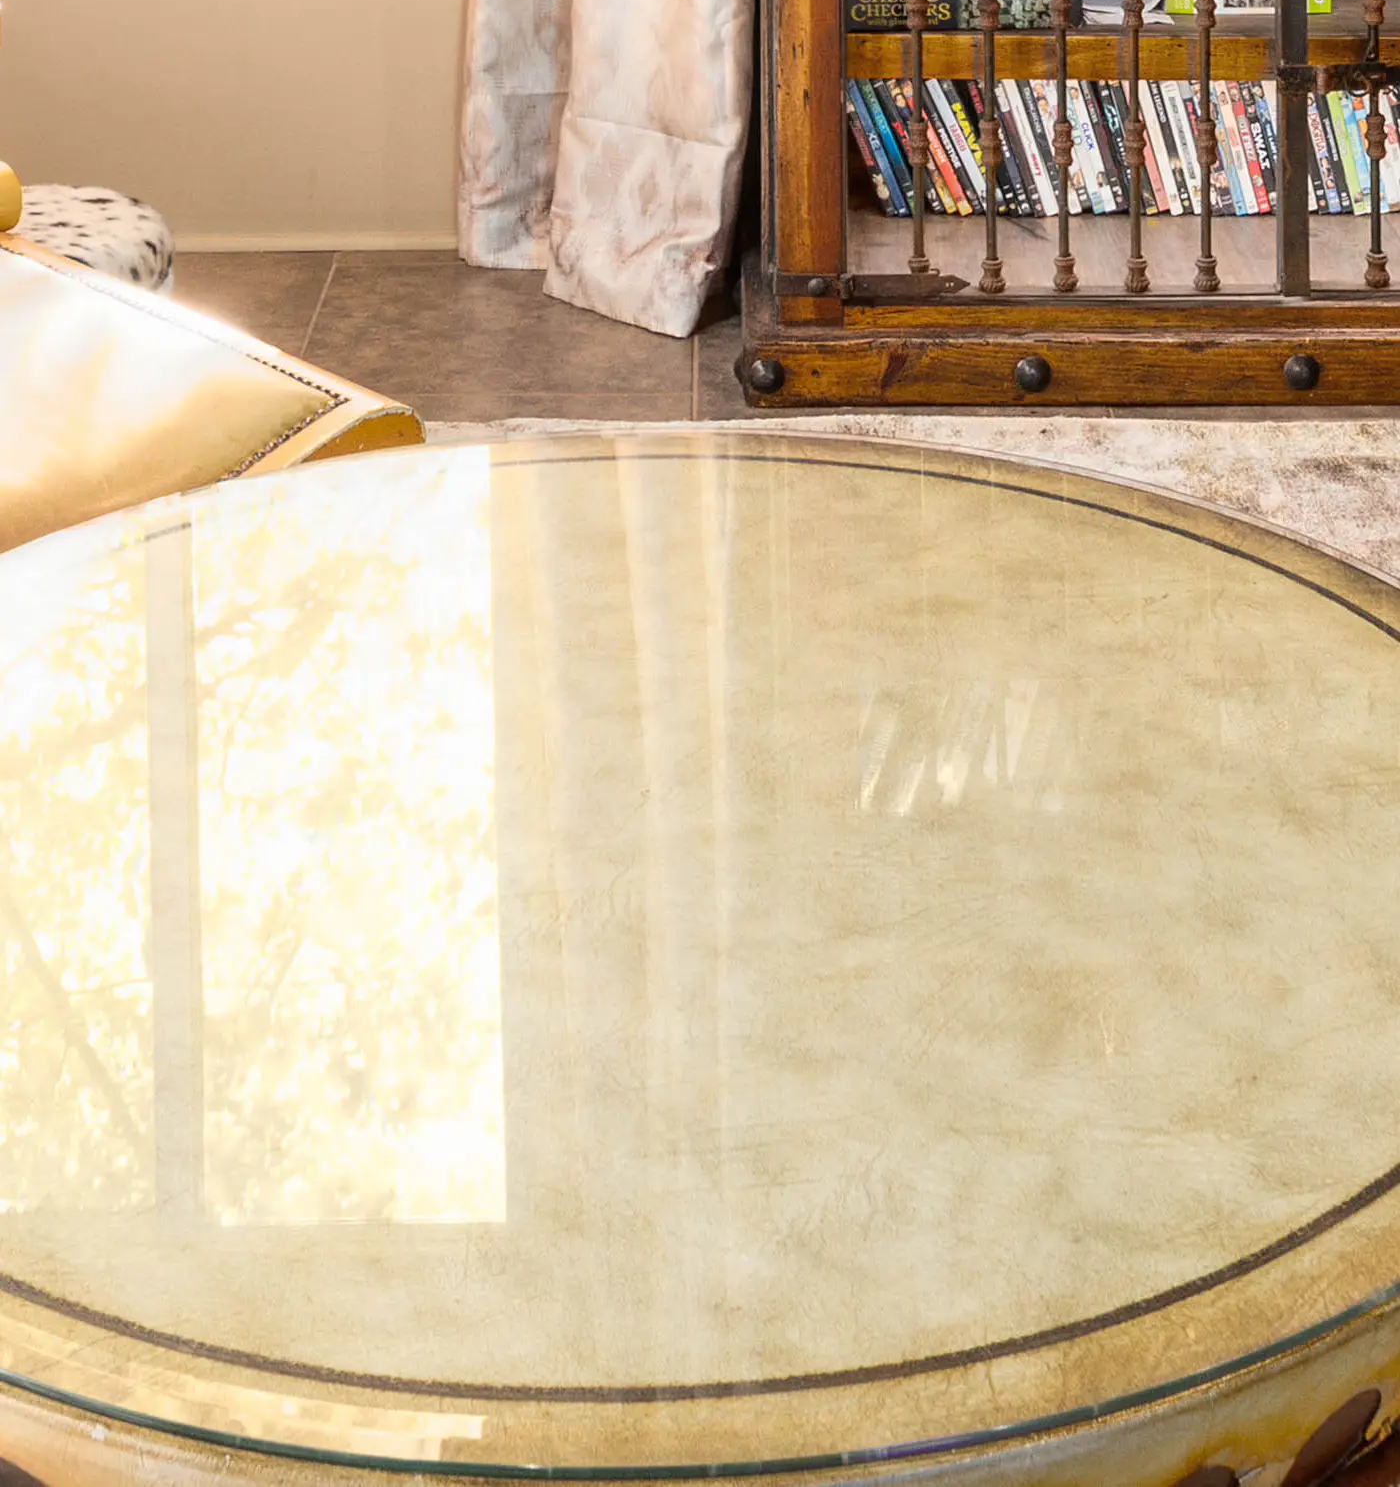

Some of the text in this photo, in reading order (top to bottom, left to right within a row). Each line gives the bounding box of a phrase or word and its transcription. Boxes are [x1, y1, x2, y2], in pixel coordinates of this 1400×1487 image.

[850, 2, 952, 22] CHECRS
[1154, 96, 1168, 124] LEGEND
[938, 128, 961, 169] PRESTIGE
[1081, 121, 1095, 151] CLICK
